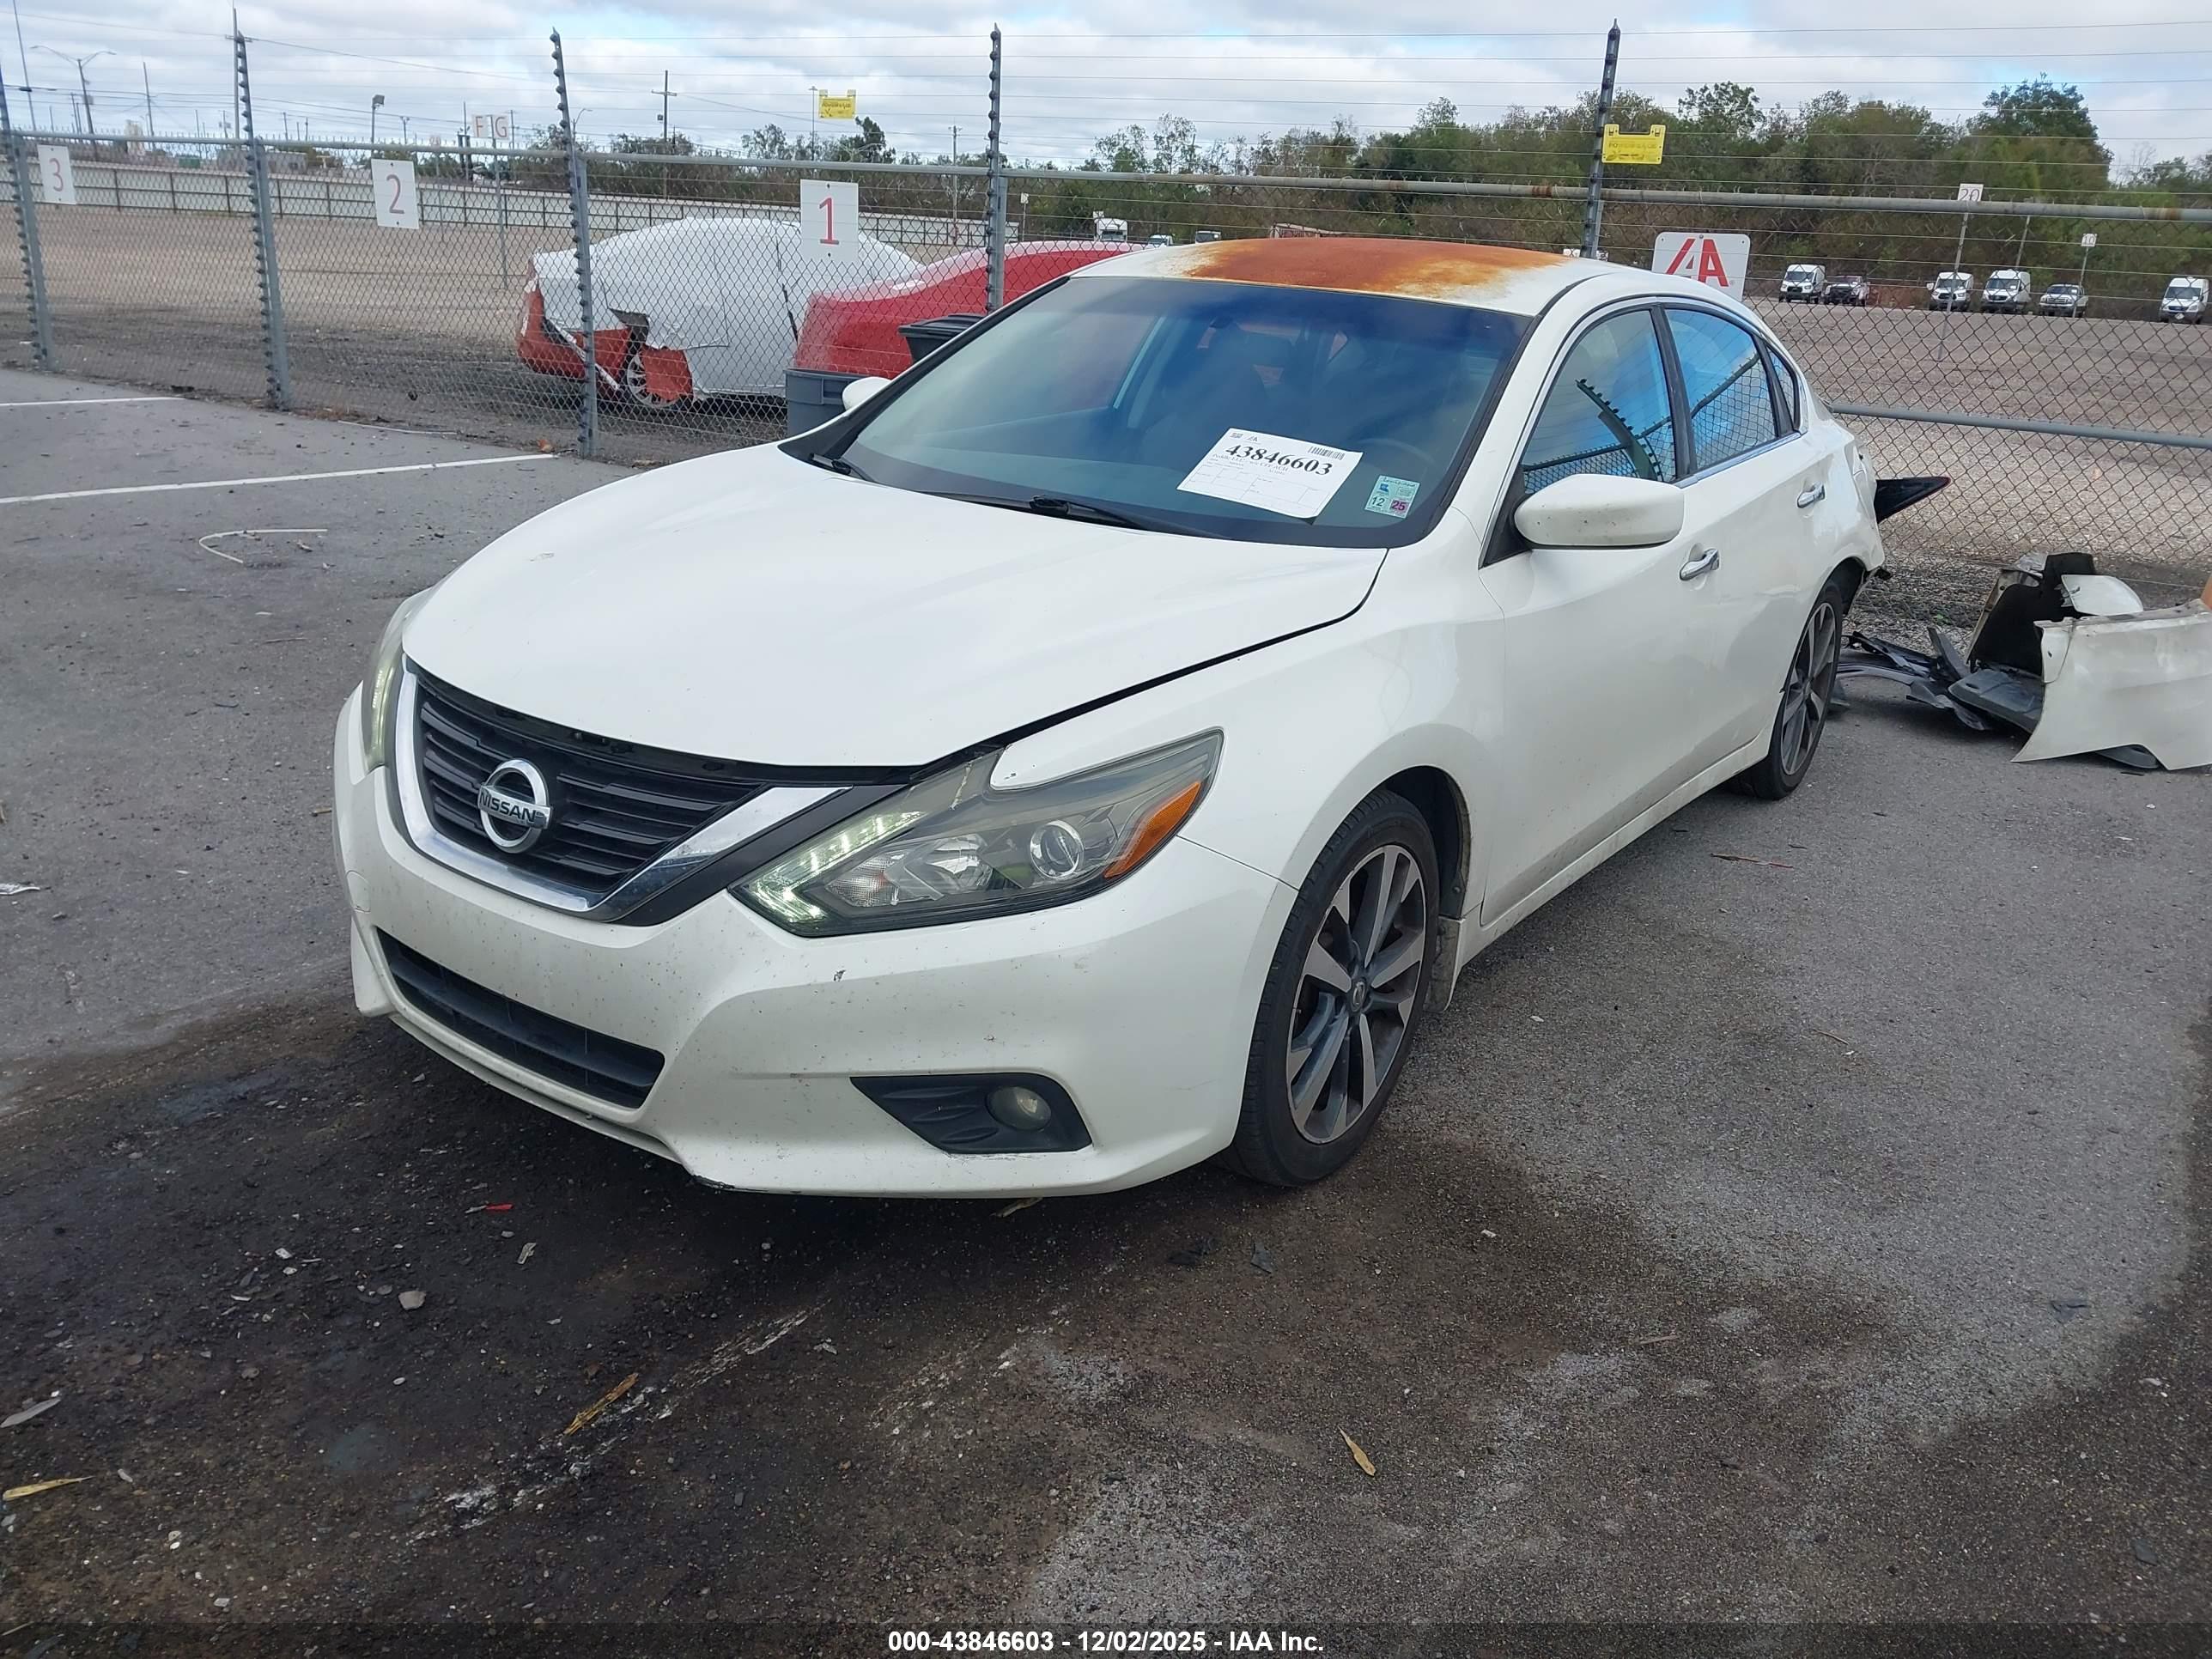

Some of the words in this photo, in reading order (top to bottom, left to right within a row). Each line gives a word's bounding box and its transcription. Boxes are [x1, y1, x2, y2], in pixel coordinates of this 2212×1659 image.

[495, 116, 507, 137] G
[49, 157, 64, 192] 3
[386, 174, 405, 215] 2
[818, 198, 840, 246] 1
[1225, 444, 1333, 476] 43846603
[1372, 496, 1385, 507] 12
[1391, 501, 1406, 511] 25
[481, 790, 537, 823] NISSAN
